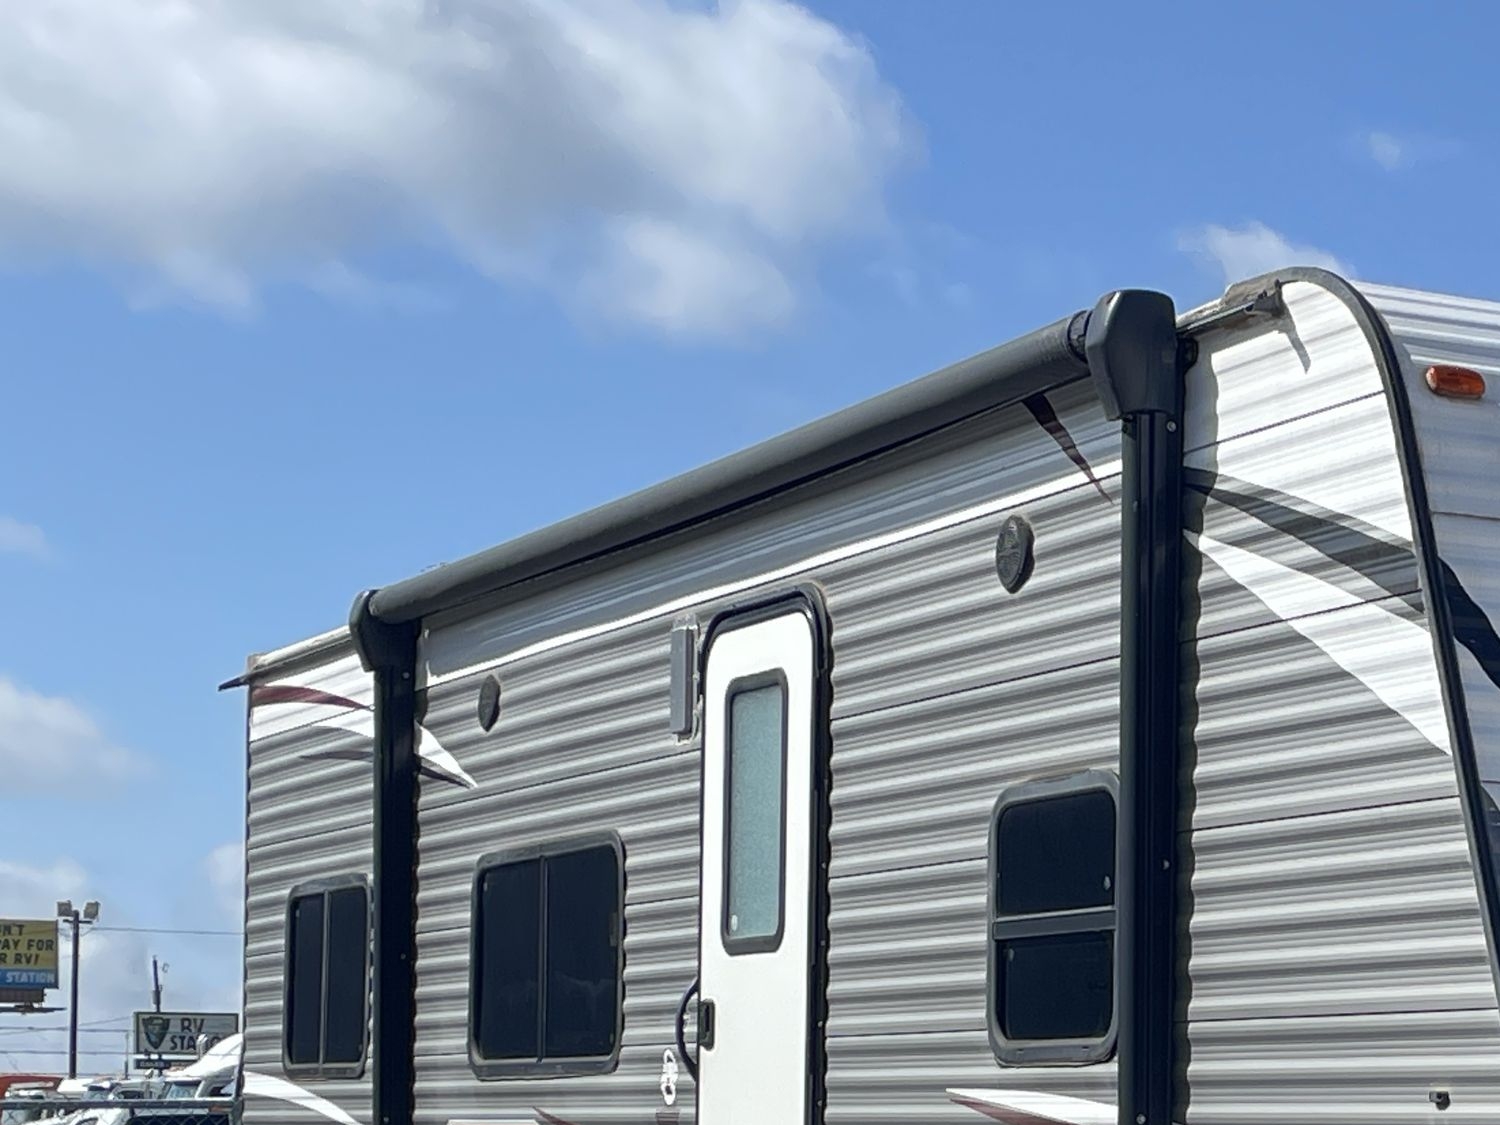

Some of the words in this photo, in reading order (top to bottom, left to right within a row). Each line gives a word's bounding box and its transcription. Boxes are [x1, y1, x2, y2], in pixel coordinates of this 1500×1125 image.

[0, 923, 24, 937] N'T
[27, 938, 55, 952] FOR
[5, 970, 56, 984] STATION
[181, 1017, 205, 1033] RV
